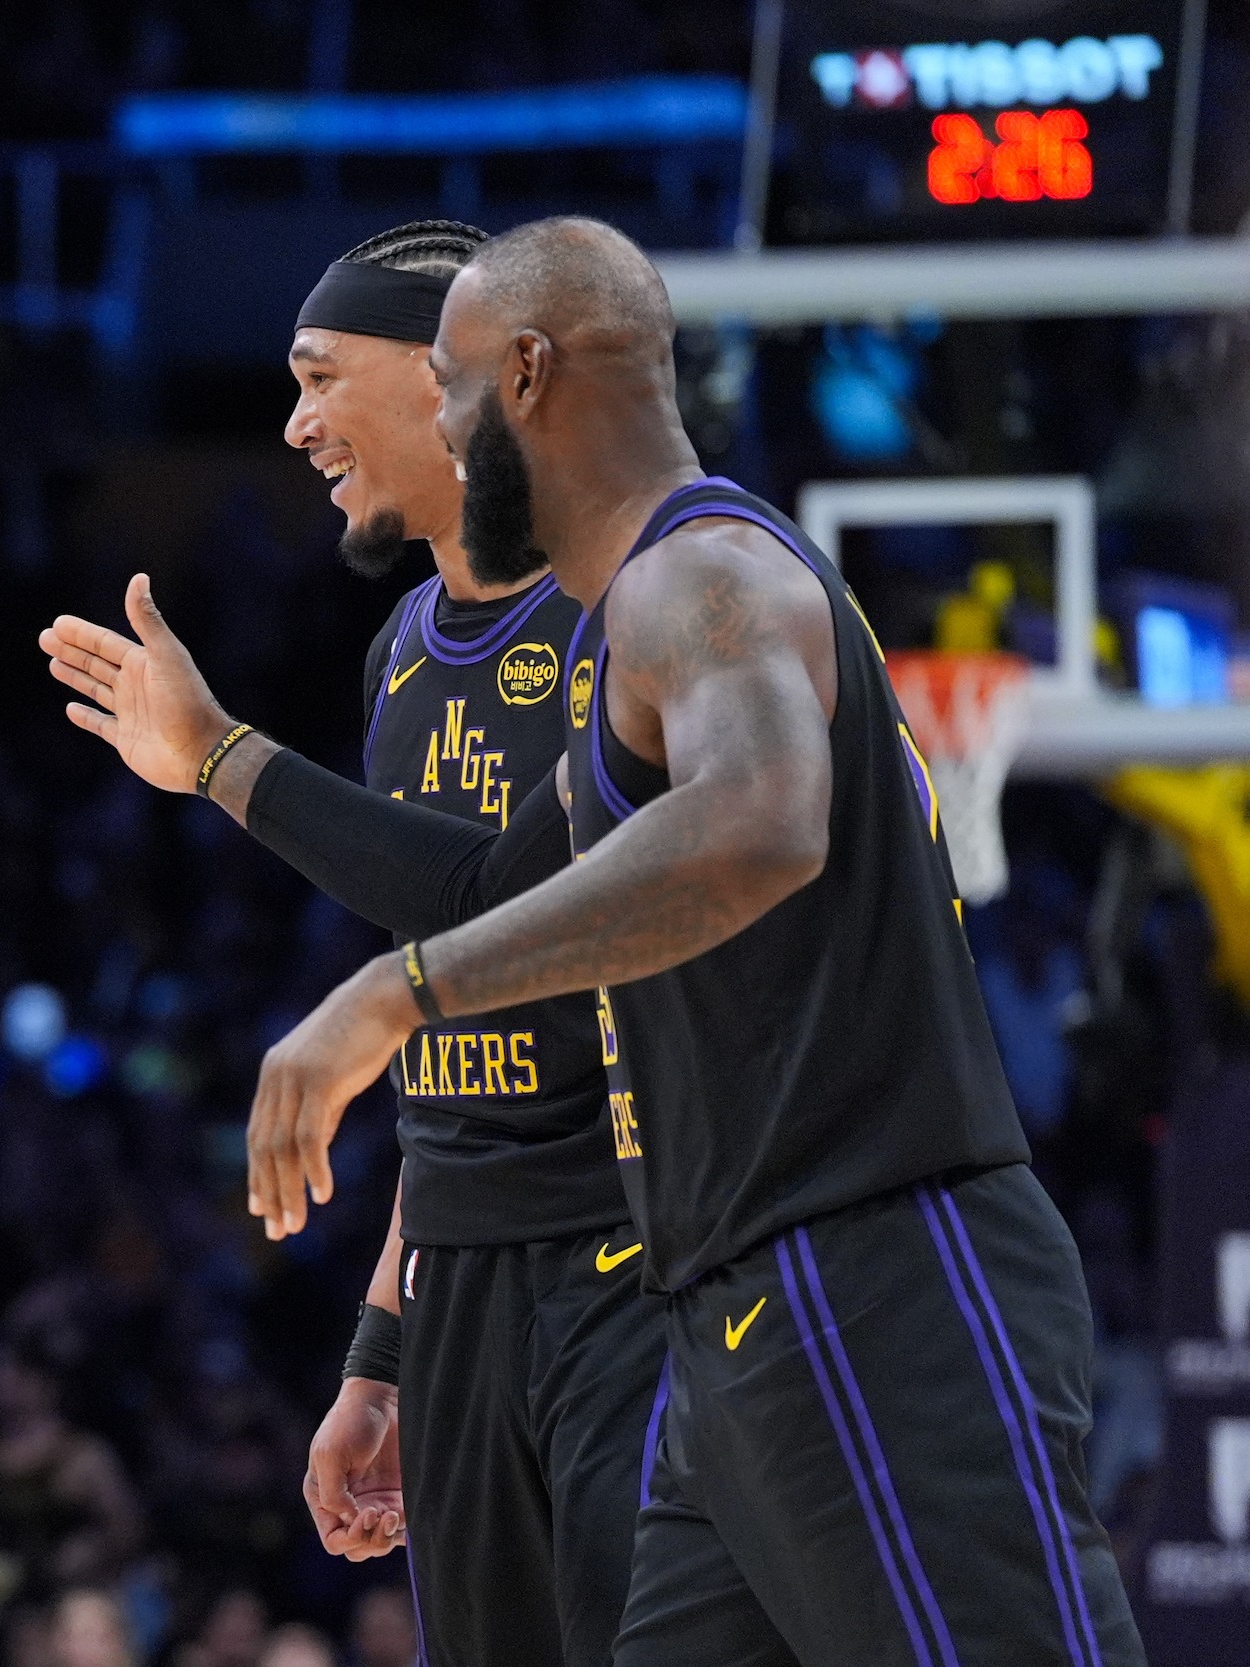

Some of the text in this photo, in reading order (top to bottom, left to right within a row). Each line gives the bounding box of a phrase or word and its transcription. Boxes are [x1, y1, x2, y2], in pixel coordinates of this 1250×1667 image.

[503, 659, 554, 687] bibigo
[421, 698, 511, 832] ANGEL
[401, 1031, 539, 1097] LAKERS
[608, 1090, 643, 1160] ERS
